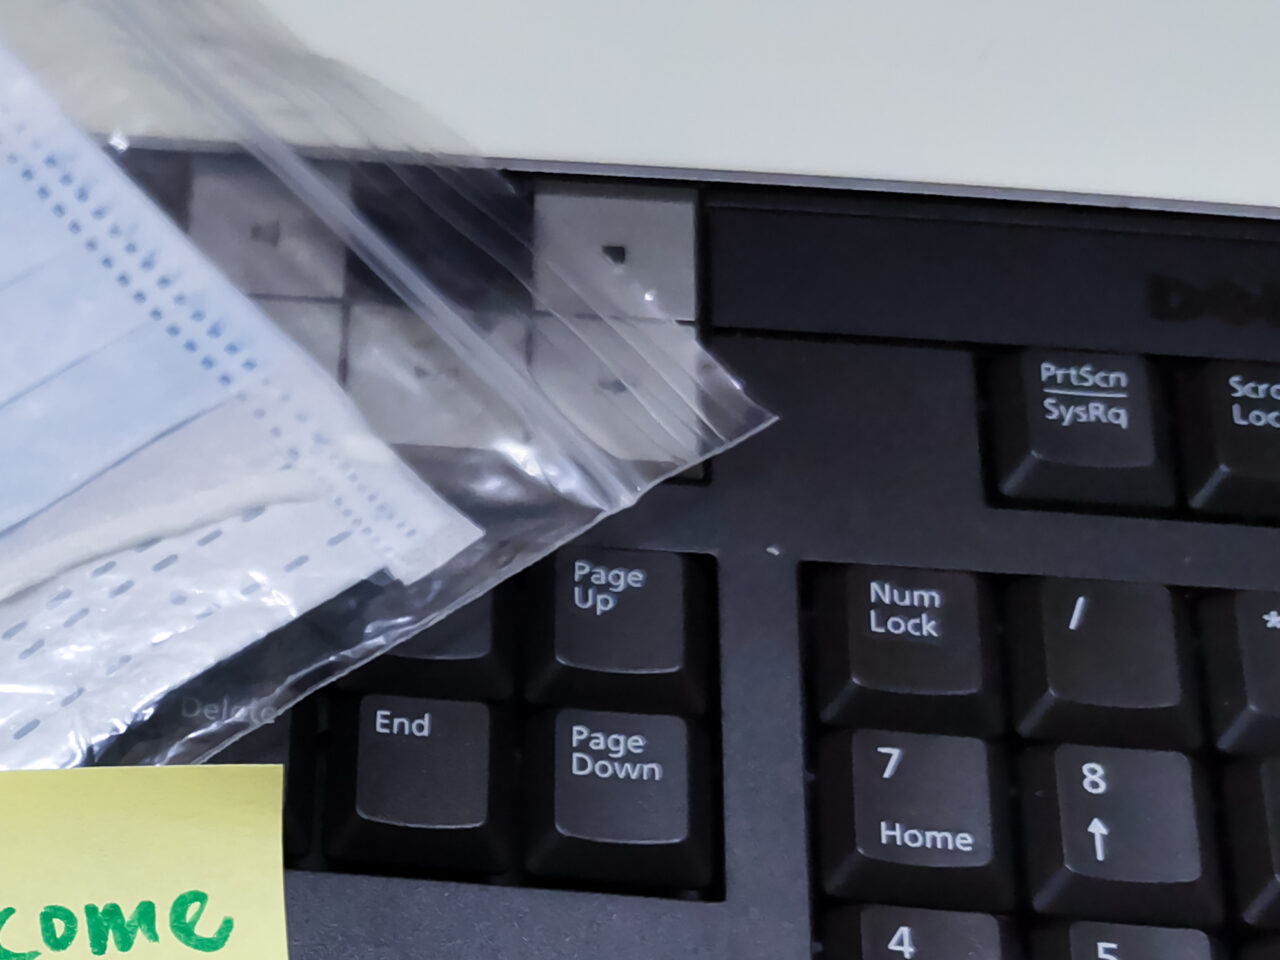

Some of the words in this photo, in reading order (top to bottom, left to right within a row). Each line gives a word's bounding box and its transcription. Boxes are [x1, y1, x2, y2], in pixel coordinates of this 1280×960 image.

[1040, 361, 1128, 388] PrtScn
[1043, 398, 1129, 430] SysRq
[573, 561, 646, 591] Page
[573, 587, 617, 616] Up
[869, 581, 942, 608] Num
[869, 609, 940, 638] Lock
[374, 709, 432, 738] End
[571, 725, 647, 755] Page
[571, 754, 664, 782] Down
[876, 746, 903, 779] 7
[1081, 761, 1108, 795] 8
[879, 820, 976, 853] Home
[886, 925, 917, 960] 4
